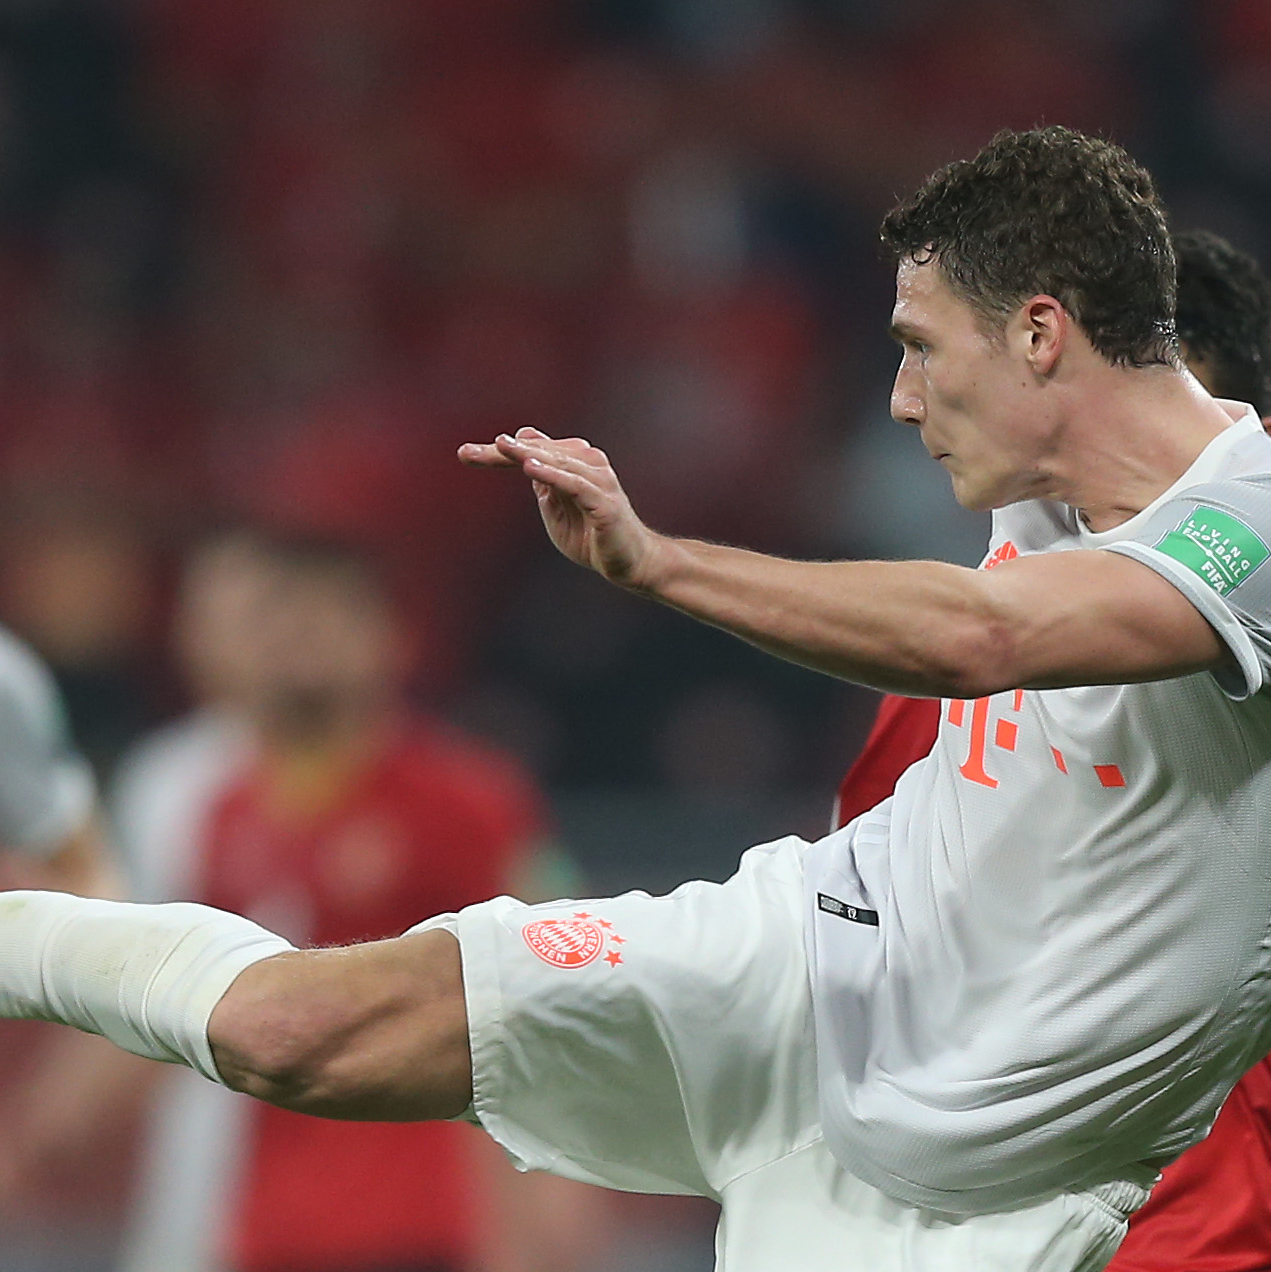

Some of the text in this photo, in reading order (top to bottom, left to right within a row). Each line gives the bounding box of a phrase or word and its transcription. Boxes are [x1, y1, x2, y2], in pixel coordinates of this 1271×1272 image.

[1182, 527, 1244, 579] FOOTBALL
[1187, 519, 1252, 571] LIVING
[1200, 560, 1228, 594] FIFA
